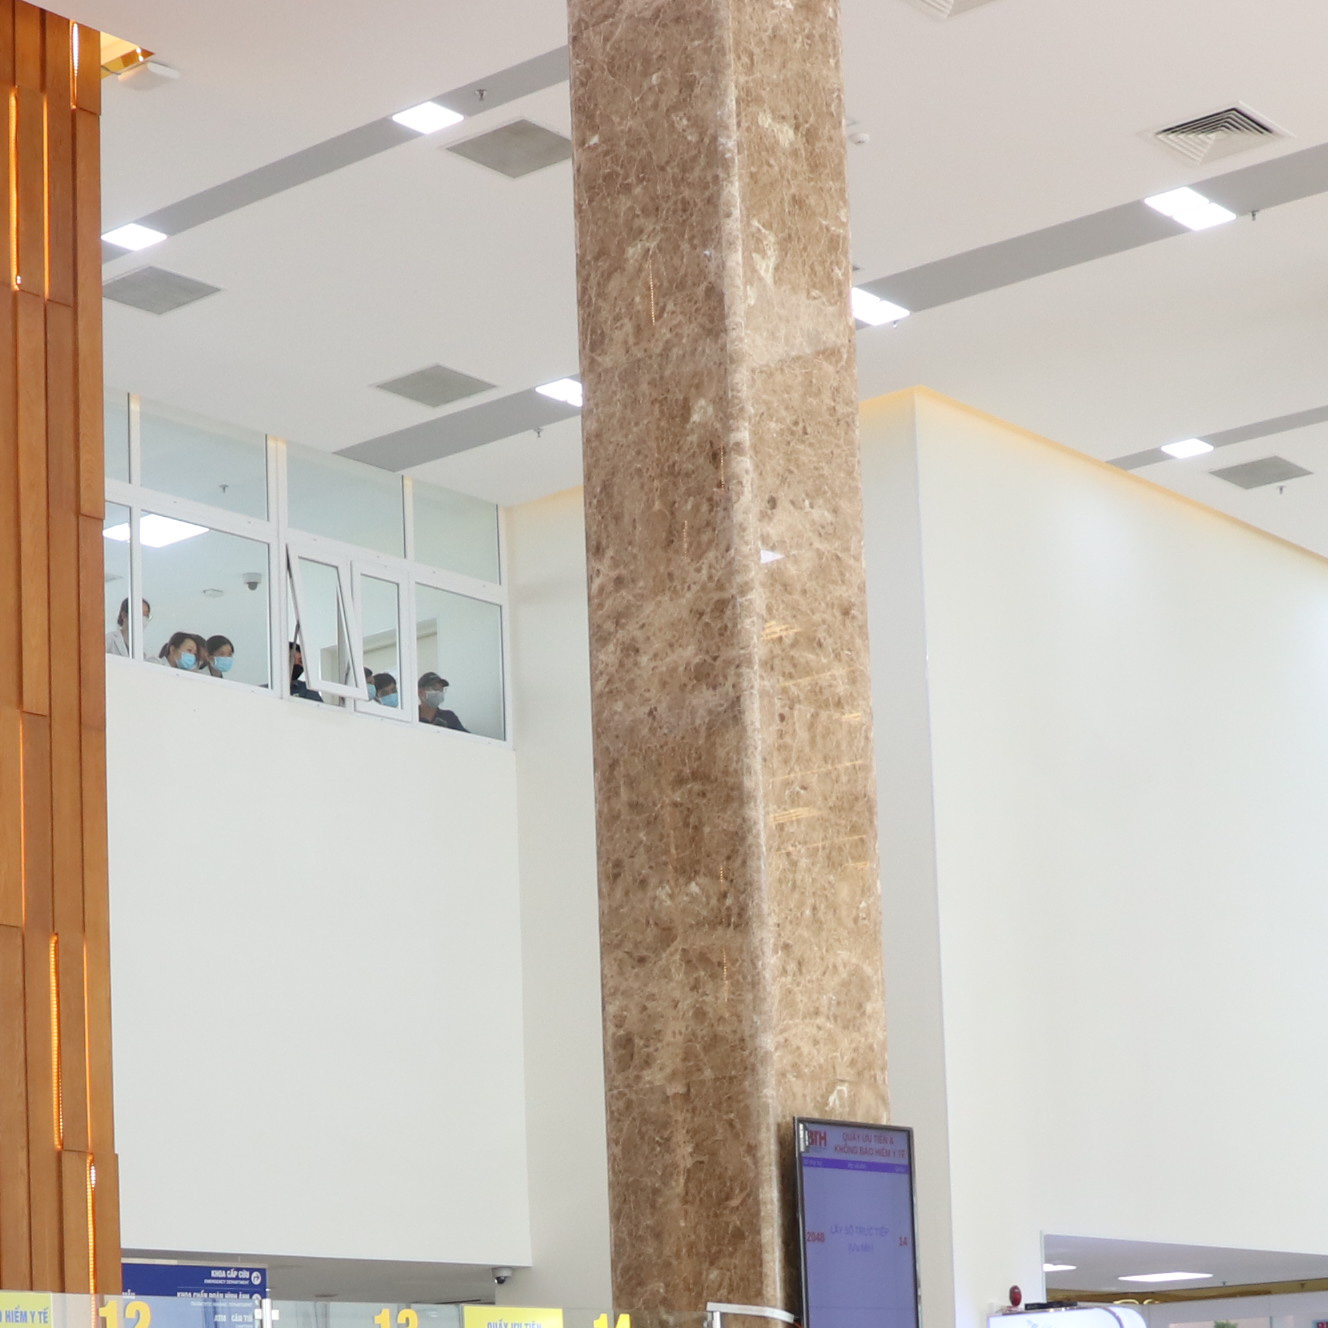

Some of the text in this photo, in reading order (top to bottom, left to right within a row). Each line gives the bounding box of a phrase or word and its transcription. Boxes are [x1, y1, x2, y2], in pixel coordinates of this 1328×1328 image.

[5, 1305, 28, 1324] HIỂM
[30, 1310, 37, 1323] Y
[37, 1307, 49, 1324] TẾ
